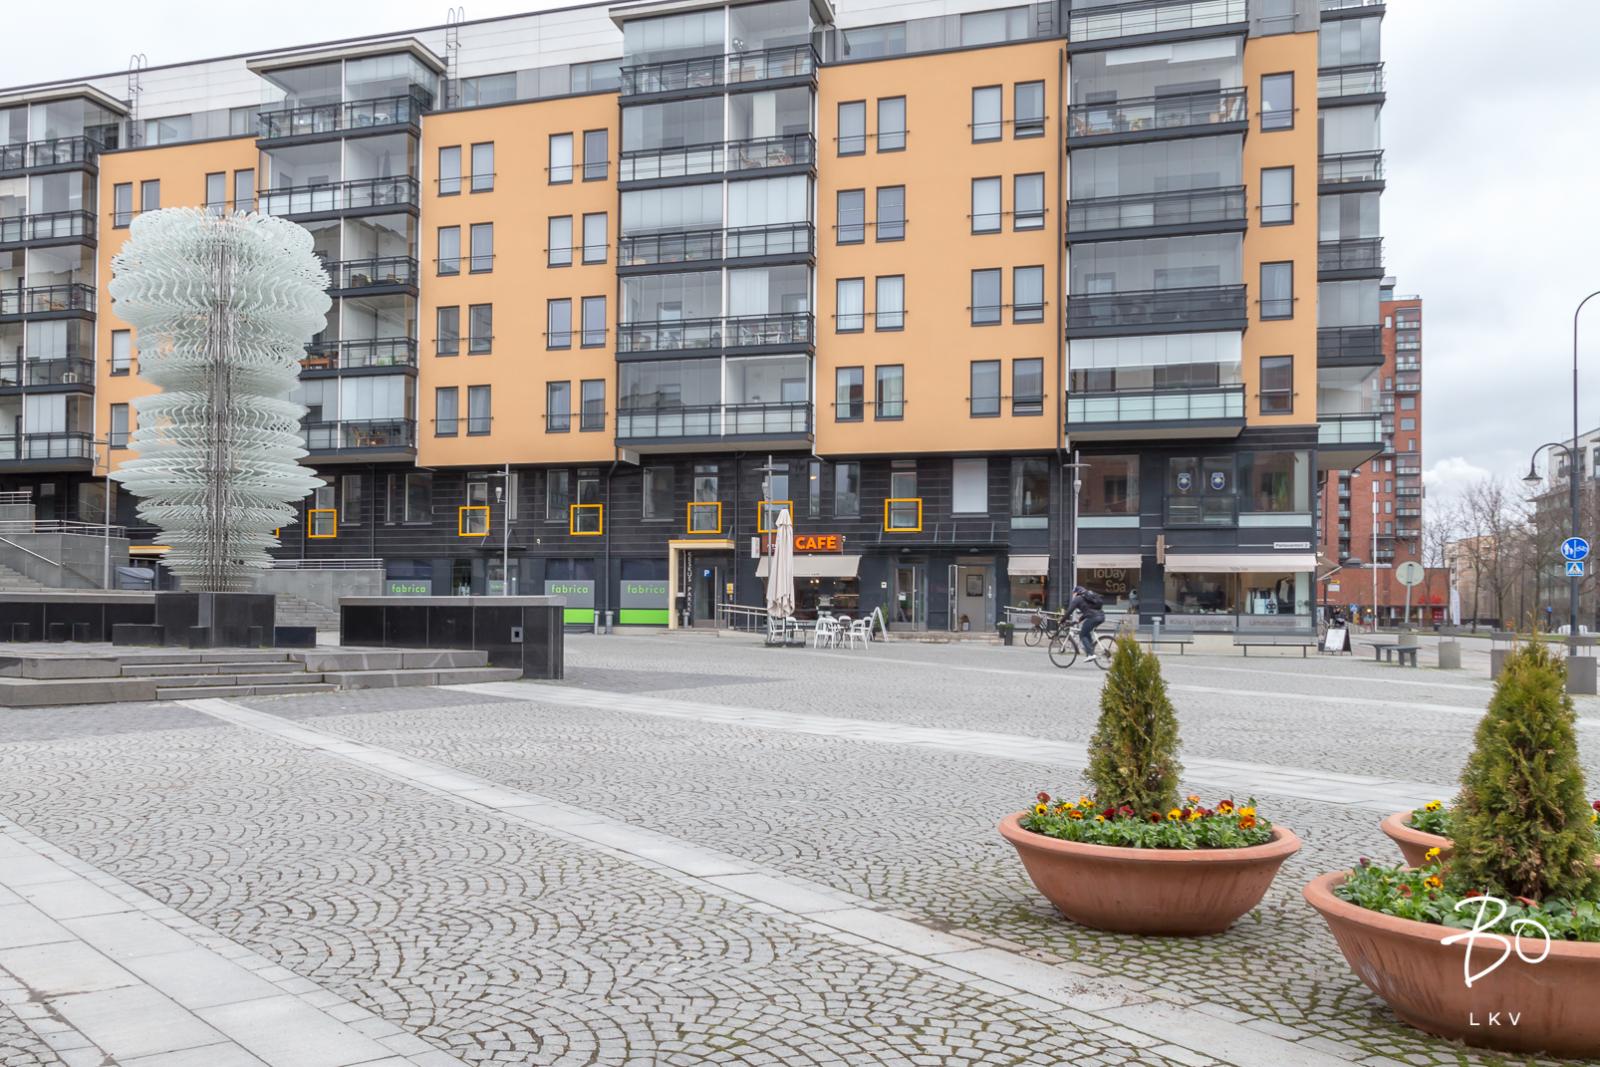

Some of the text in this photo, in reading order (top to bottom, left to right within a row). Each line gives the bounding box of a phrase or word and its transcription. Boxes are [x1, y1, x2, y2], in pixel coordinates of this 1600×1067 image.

[704, 569, 711, 577] P
[391, 583, 427, 593] fabrica
[551, 584, 589, 594] fabrica
[626, 584, 666, 594] fabrica
